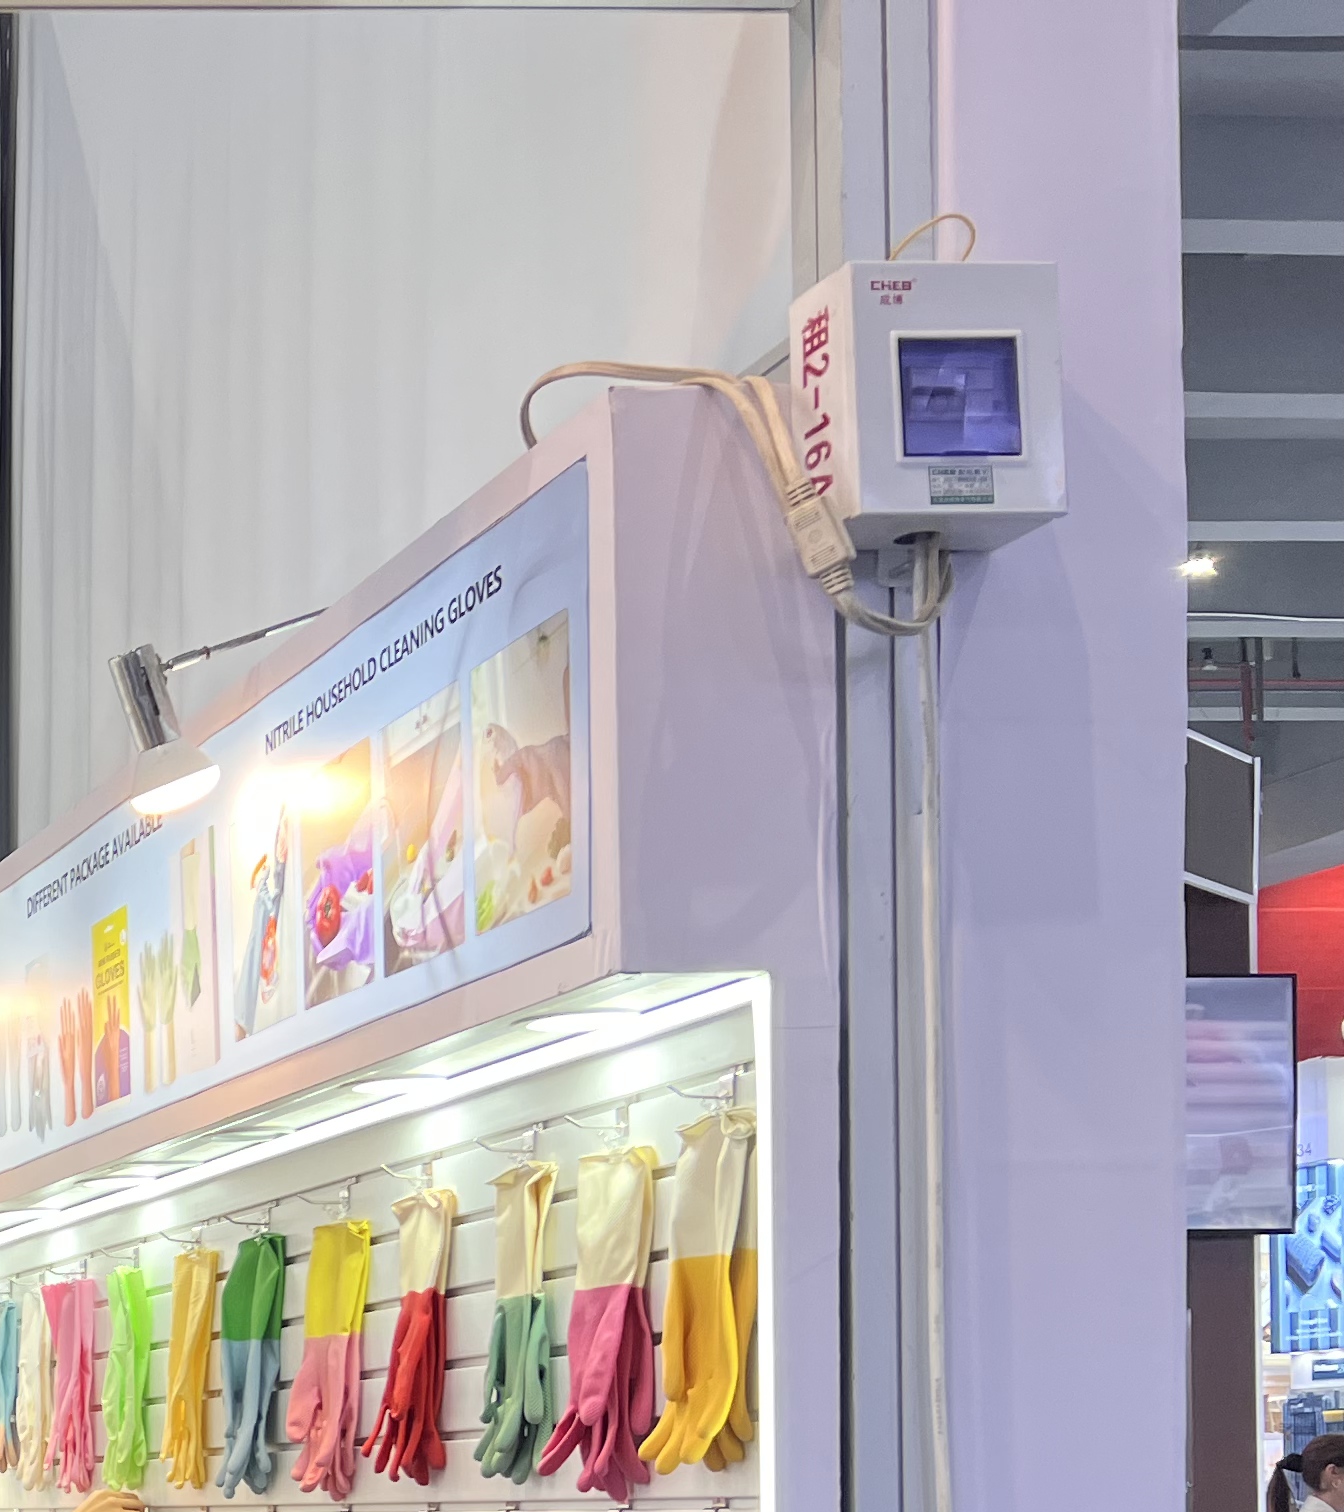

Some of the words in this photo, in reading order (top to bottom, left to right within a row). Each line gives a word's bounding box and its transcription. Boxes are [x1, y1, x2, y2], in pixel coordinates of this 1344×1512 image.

[264, 708, 304, 756] NITRILE
[305, 656, 377, 728] HOUSEHOLD
[379, 606, 446, 673] CLEANING
[447, 564, 503, 625] GLOVES
[26, 871, 69, 919] DIFFERENT
[69, 842, 111, 891] PACKAGE
